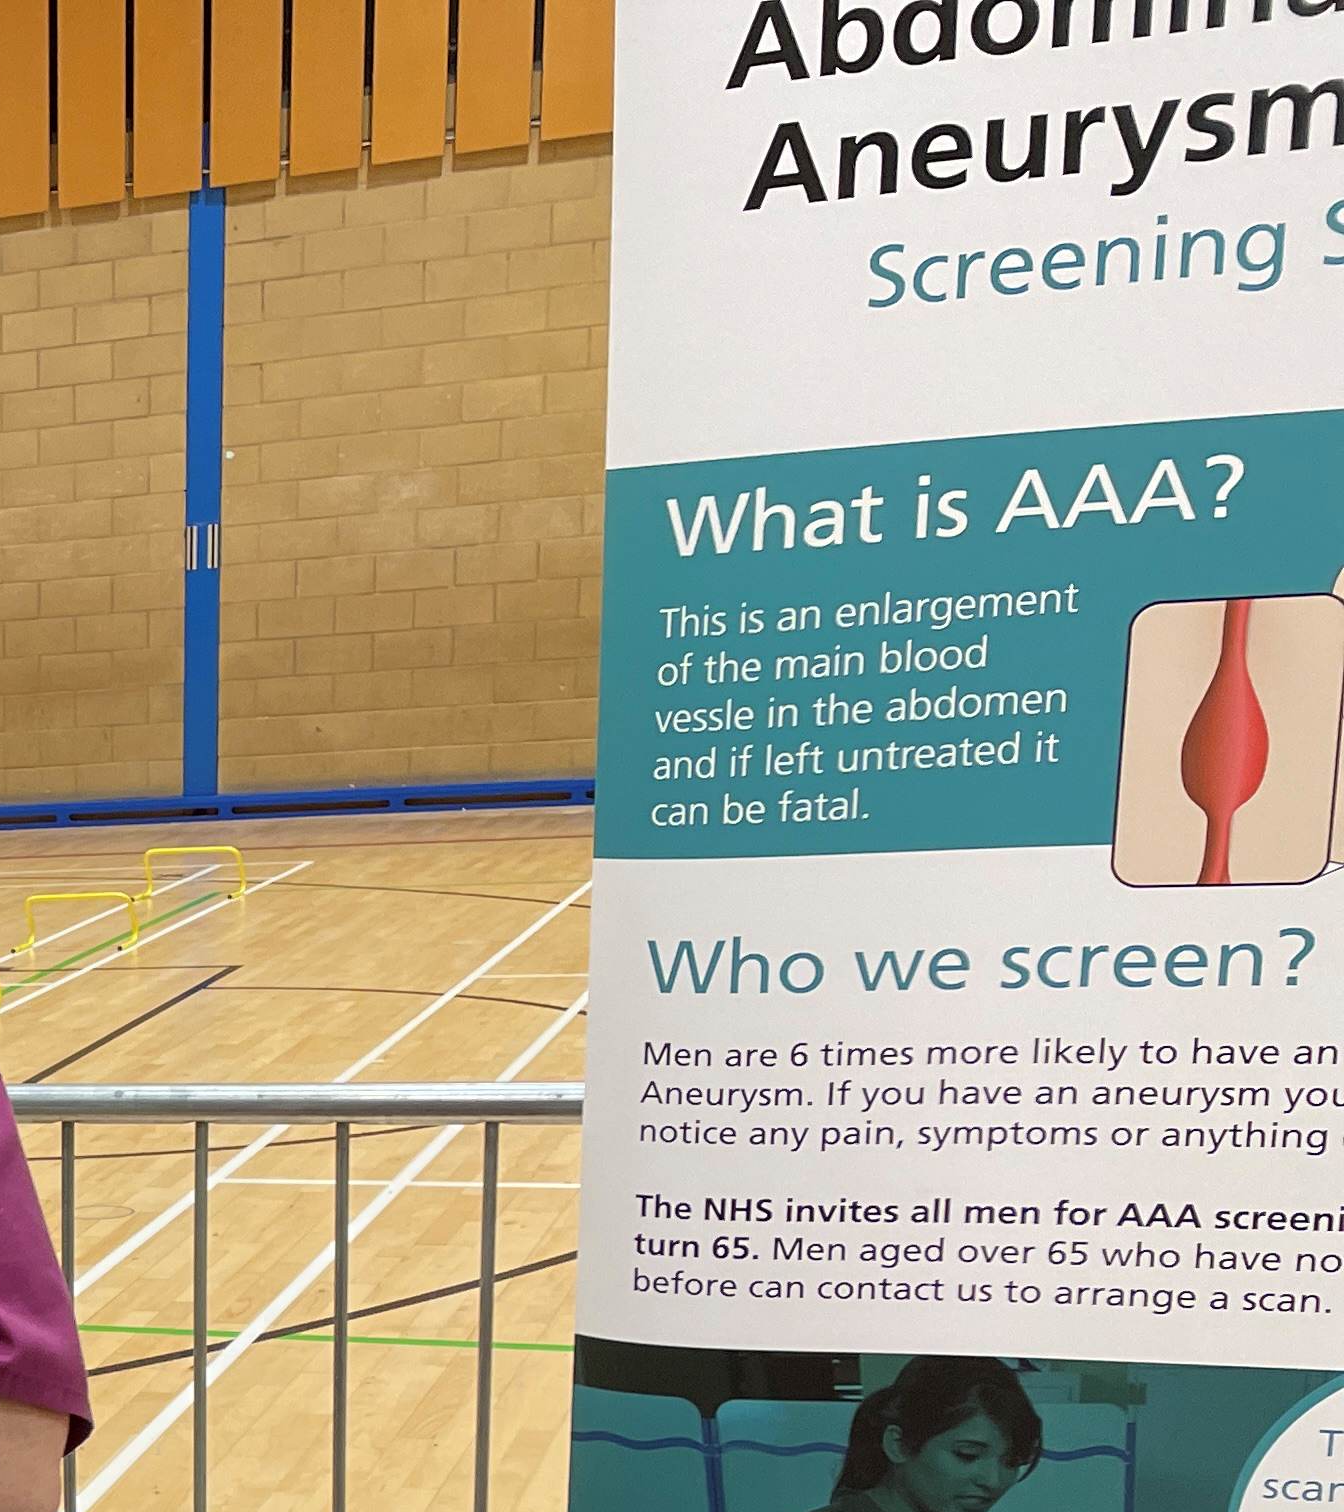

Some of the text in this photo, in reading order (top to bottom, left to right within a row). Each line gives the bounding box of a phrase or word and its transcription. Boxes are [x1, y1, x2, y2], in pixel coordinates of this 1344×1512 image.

[743, 76, 1344, 211] Aneurysm
[867, 214, 1286, 309] Screening
[666, 454, 1246, 557] What is AAA?
[658, 583, 1080, 639] This enlargement
[703, 634, 988, 684] the main blood
[655, 685, 1067, 734] vessle the abdomen
[653, 730, 1021, 781] and left untreated
[651, 787, 869, 827] can fatal.
[647, 927, 1316, 994] Who we screen?
[643, 1037, 1280, 1072] Men times more likely have
[640, 1078, 1344, 1114] Aneurysm. you have aneurysm you
[640, 1119, 1328, 1156] notice any pain, symptoms anything
[635, 1193, 692, 1220] The
[704, 1197, 773, 1222] NHS
[786, 1197, 899, 1223] invites
[910, 1197, 951, 1224] all
[964, 1205, 1041, 1225] men
[1053, 1199, 1108, 1226] for
[1116, 1202, 1202, 1229] AAA
[634, 1233, 1343, 1273] turn 65. Men aged over 65 who have no
[633, 1267, 1331, 1315] before can contact arrange scan.
